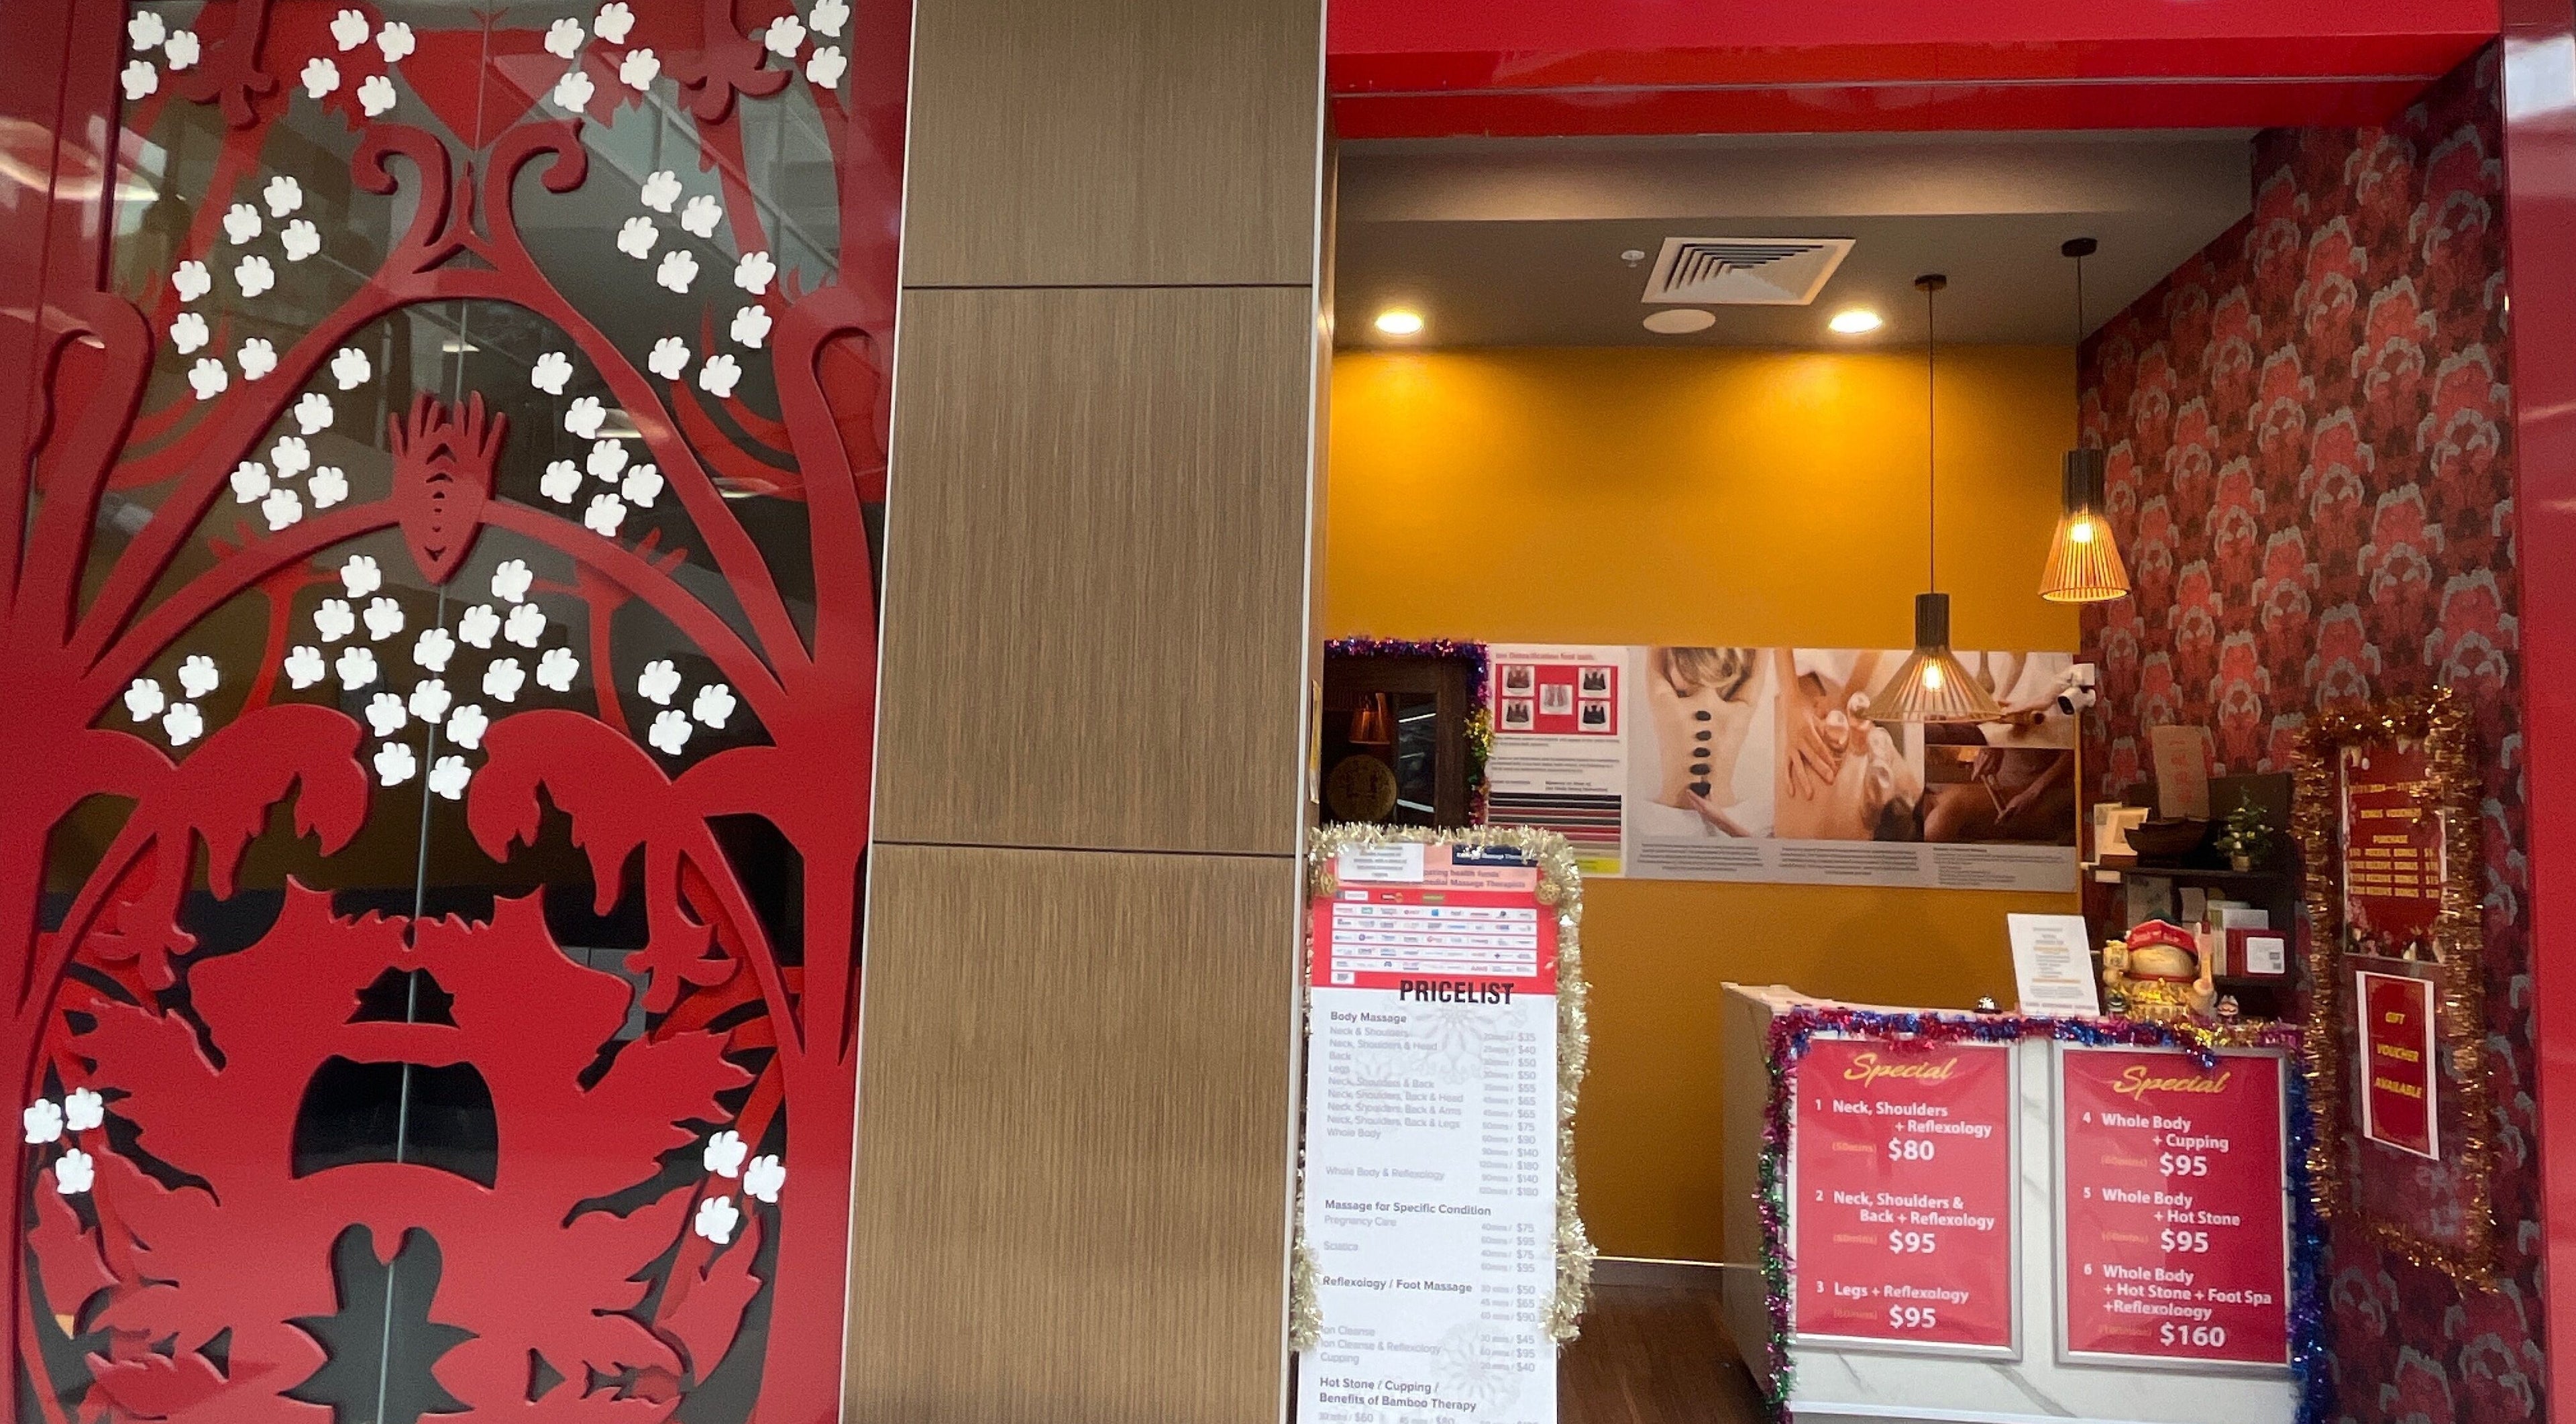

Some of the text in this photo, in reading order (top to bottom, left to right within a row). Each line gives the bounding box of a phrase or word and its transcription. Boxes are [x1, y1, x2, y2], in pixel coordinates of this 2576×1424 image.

[1399, 980, 1514, 1005] PRICELIST
[1330, 1011, 1407, 1024] Body Massage
[1330, 1027, 1352, 1036] Neck
[1364, 1028, 1408, 1038] Shoulders
[1517, 1032, 1536, 1042] $35
[1413, 1042, 1437, 1051] Head
[1517, 1045, 1536, 1056] $40
[2377, 1043, 2418, 1062] VOUCHER
[1329, 1052, 1351, 1060] Back
[1328, 1064, 1350, 1074] Legs
[1517, 1058, 1536, 1068] $50
[1517, 1071, 1536, 1081] $50
[1843, 1052, 1957, 1089] Special
[1412, 1079, 1435, 1089] Back
[1517, 1084, 1536, 1093] $55
[2113, 1065, 2231, 1101] Special
[2375, 1077, 2422, 1099] AVAILABLE
[1405, 1092, 1428, 1101] Back
[1439, 1094, 1464, 1103] Head
[1517, 1096, 1536, 1106] $65
[1405, 1105, 1427, 1114] Back
[1439, 1106, 1462, 1115] Arms
[1517, 1109, 1536, 1119] $65
[1815, 1099, 1948, 1117] 1 Neck, Shoulders
[1355, 1116, 1403, 1127] Shoulders,
[1405, 1118, 1427, 1128] Back
[1438, 1119, 1460, 1130] Legs
[1517, 1122, 1535, 1132] $75
[2082, 1112, 2191, 1133] 4 Whole Body
[1327, 1128, 1381, 1140] Whole Body
[1895, 1120, 1992, 1138] + Reflexology
[1517, 1135, 1536, 1145] $90
[2152, 1134, 2229, 1152] + Cupping
[1517, 1148, 1539, 1158] $140
[1888, 1137, 1935, 1162] $80
[2159, 1152, 2208, 1177] $95
[1326, 1166, 1354, 1176] Whole
[1356, 1167, 1380, 1179] Body
[1392, 1169, 1445, 1181] Reflexology
[1517, 1174, 1539, 1184] $140
[1816, 1190, 1964, 1209] 2 Neck, Shoulders &
[2083, 1187, 2193, 1208] 5 Whole Body
[1326, 1199, 1491, 1216] Massage for Specific Condition
[1324, 1215, 1397, 1227] Pregnancy Care
[1860, 1209, 1994, 1231] Back + Reflexology
[2154, 1211, 2241, 1226] + Hot Stone
[1517, 1223, 1535, 1234] $75
[1517, 1236, 1536, 1246] $95
[1888, 1229, 1936, 1254] $95
[2160, 1227, 2209, 1253] $95
[1517, 1250, 1535, 1260] $75
[1517, 1263, 1536, 1273] $95
[2084, 1264, 2194, 1286] 6 Whole Body
[1322, 1276, 1472, 1295] Reflexology / Foot Massage
[1517, 1284, 1536, 1295] $50
[1816, 1280, 1970, 1305] 3 Legs + Reflexology
[2104, 1283, 2272, 1307] + Hot Stone + Foot Spa
[1517, 1298, 1535, 1309] $65
[1517, 1311, 1536, 1322] $90
[1889, 1304, 1937, 1329] $95
[1338, 1325, 1375, 1336] Cleanse
[2160, 1321, 2226, 1348] $160
[1517, 1333, 1535, 1344] $45
[1338, 1339, 1375, 1350] Cleanse
[1377, 1341, 1384, 1351] &
[1387, 1342, 1442, 1355] Reflexology
[1517, 1348, 1536, 1358] $95
[1320, 1352, 1360, 1366] Cupping
[1517, 1362, 1536, 1372] $40
[1320, 1377, 1439, 1394] Hot Stone / Cupping /
[1320, 1392, 1477, 1412] Benefits of Bamboo Therapy
